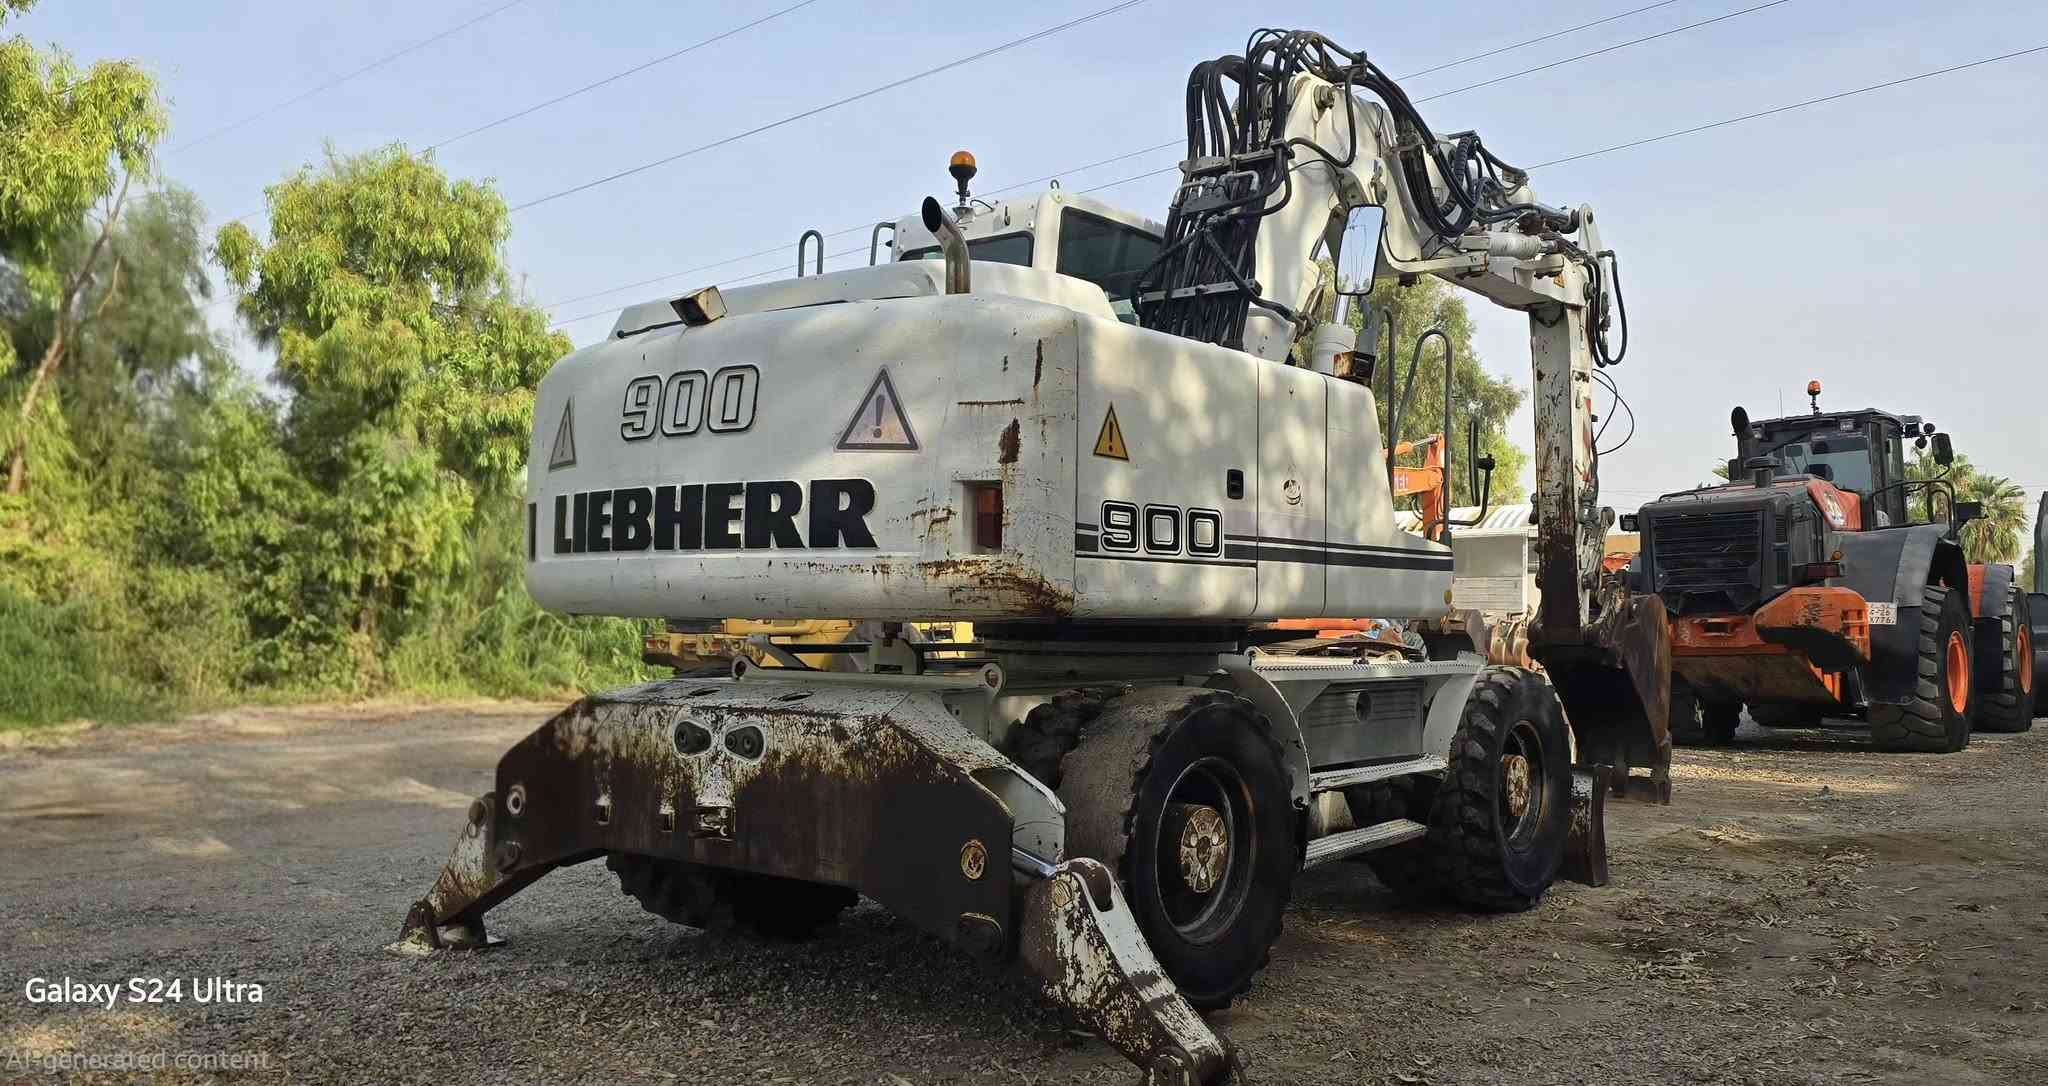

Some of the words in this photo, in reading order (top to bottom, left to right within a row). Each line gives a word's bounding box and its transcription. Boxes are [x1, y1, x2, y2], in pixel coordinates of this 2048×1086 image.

[620, 364, 759, 442] 900
[554, 478, 878, 554] LIEBHERR
[1100, 499, 1223, 558] 900
